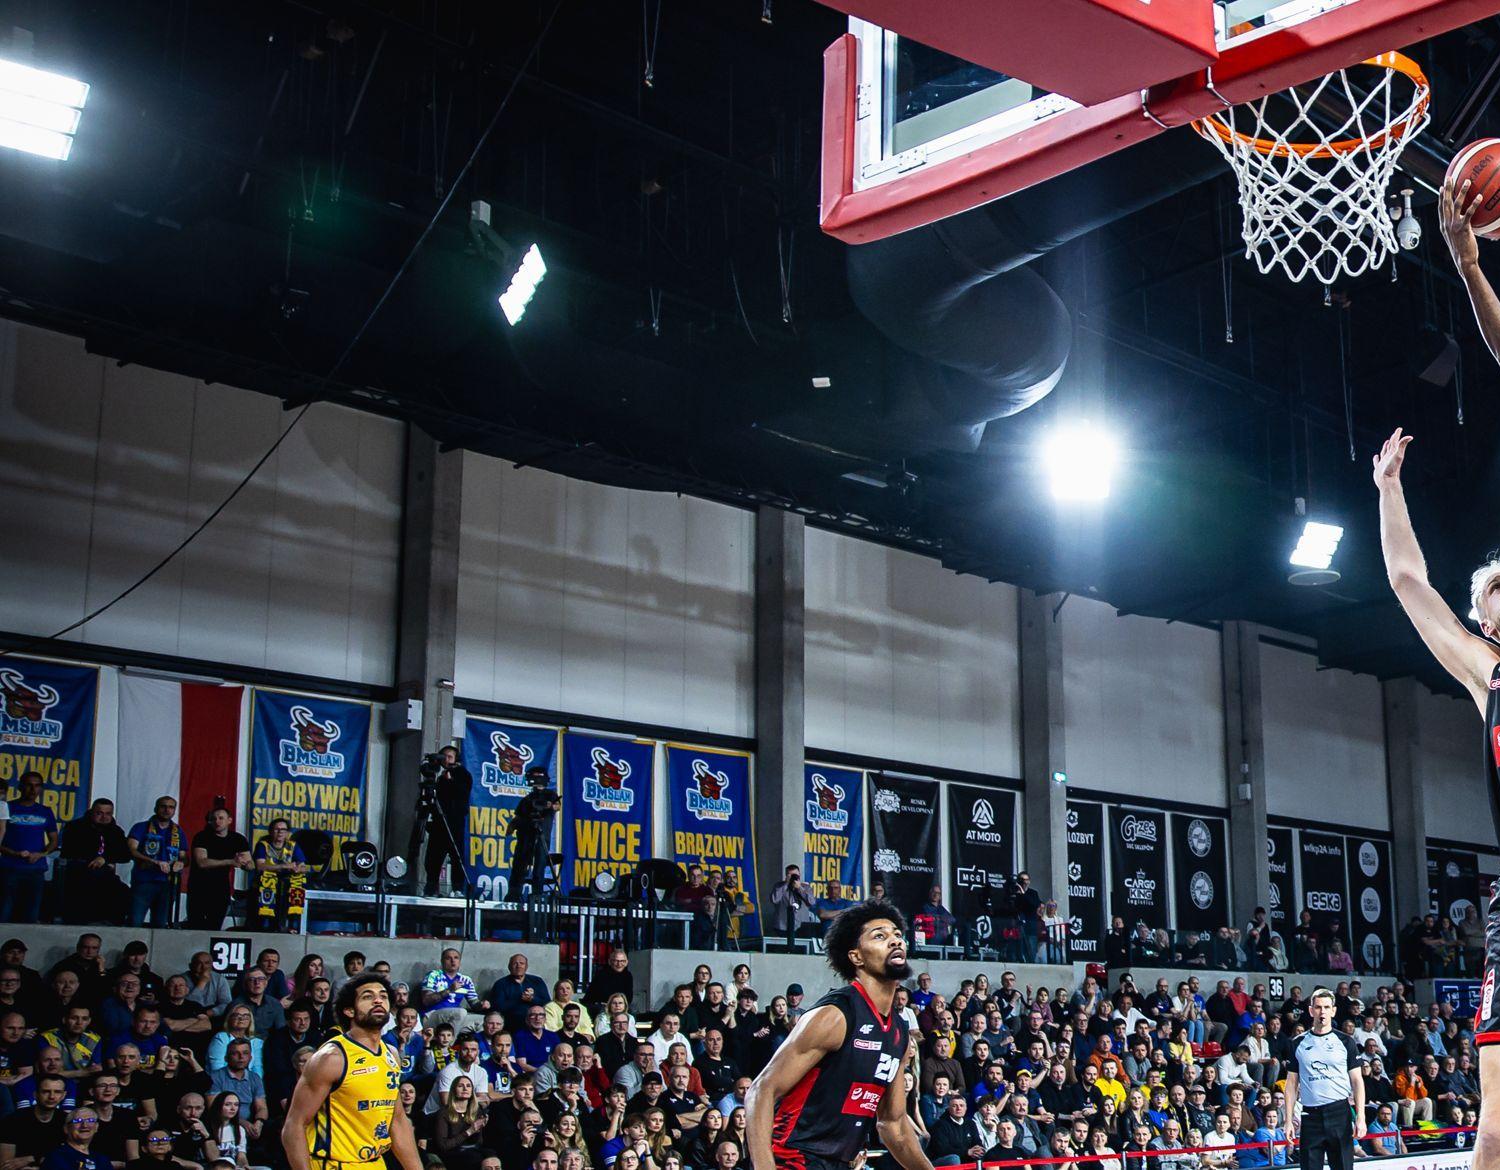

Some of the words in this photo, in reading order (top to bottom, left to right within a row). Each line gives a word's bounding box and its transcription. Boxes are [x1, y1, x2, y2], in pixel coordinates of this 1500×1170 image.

[487, 766, 527, 787] BMSLA
[254, 778, 360, 813] ZDOBYWCA
[575, 819, 641, 862] WICE
[674, 831, 745, 863] BRĄZOWY
[804, 833, 850, 857] MISTRZ
[966, 830, 976, 840] AT
[977, 831, 1001, 843] MOTO
[813, 856, 841, 881] LIGI
[1124, 878, 1156, 890] CARGO
[1130, 889, 1152, 900] KING
[212, 940, 246, 971] 34
[1269, 979, 1283, 997] 36
[859, 1024, 874, 1034] 4F
